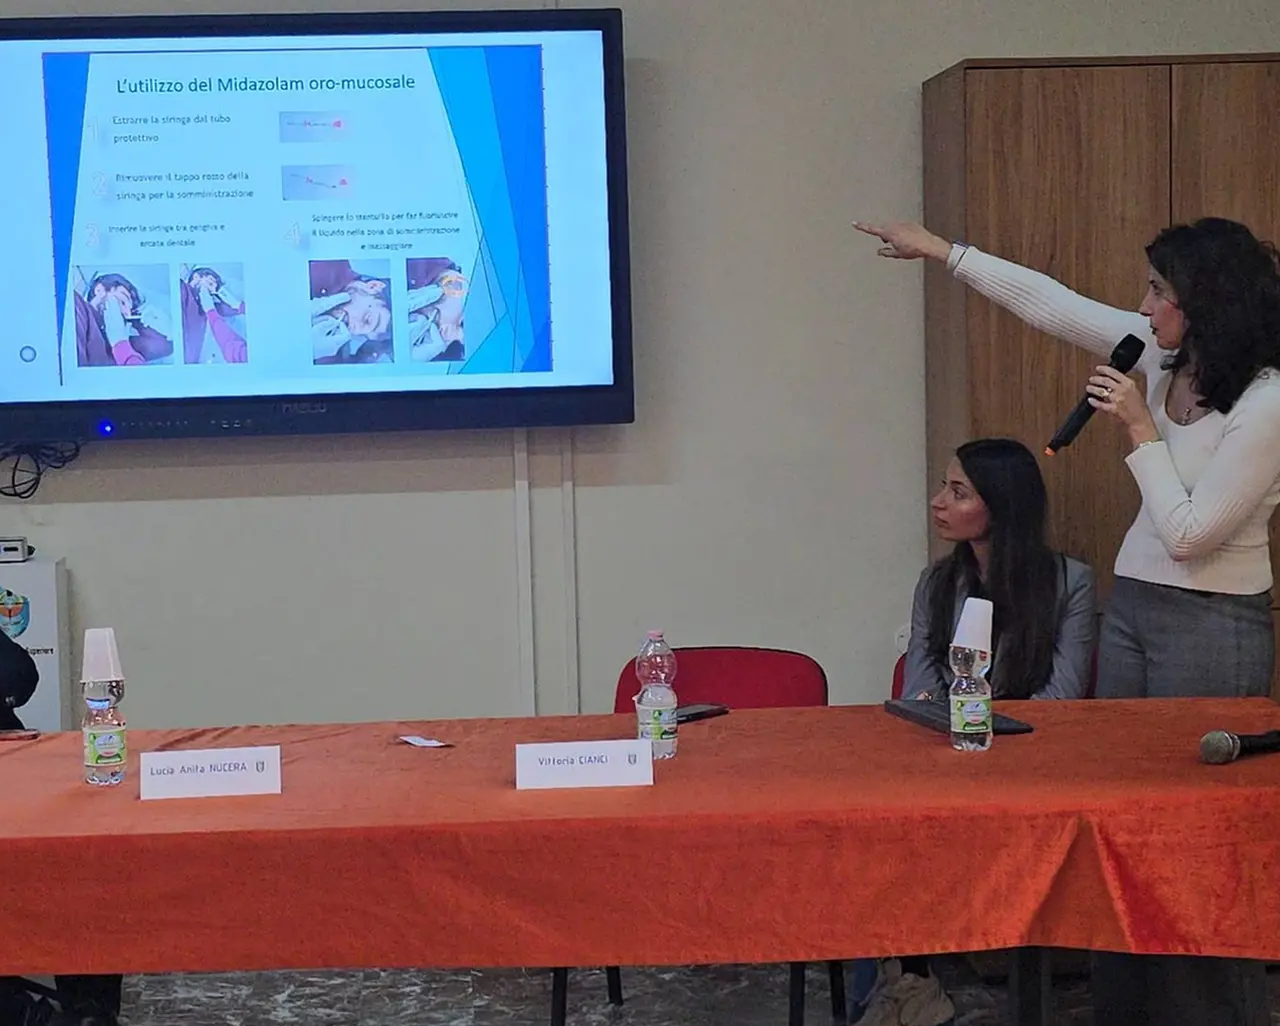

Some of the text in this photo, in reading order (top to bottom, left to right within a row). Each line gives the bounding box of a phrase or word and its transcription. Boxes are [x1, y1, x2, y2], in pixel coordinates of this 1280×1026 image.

[117, 74, 416, 94] L'utilizzo del Midazolam oro-mucosale
[112, 114, 231, 126] Estrarre la siringa dal tubo
[113, 133, 159, 144] protettivo
[174, 173, 200, 183] tappo
[202, 173, 225, 181] rosso
[227, 171, 249, 180] della
[116, 191, 146, 201] siringa
[148, 191, 164, 200] per
[166, 190, 174, 199] la
[538, 754, 608, 766] Vittoria CIANCI
[150, 762, 247, 776] Lucia Anita NUCERA
